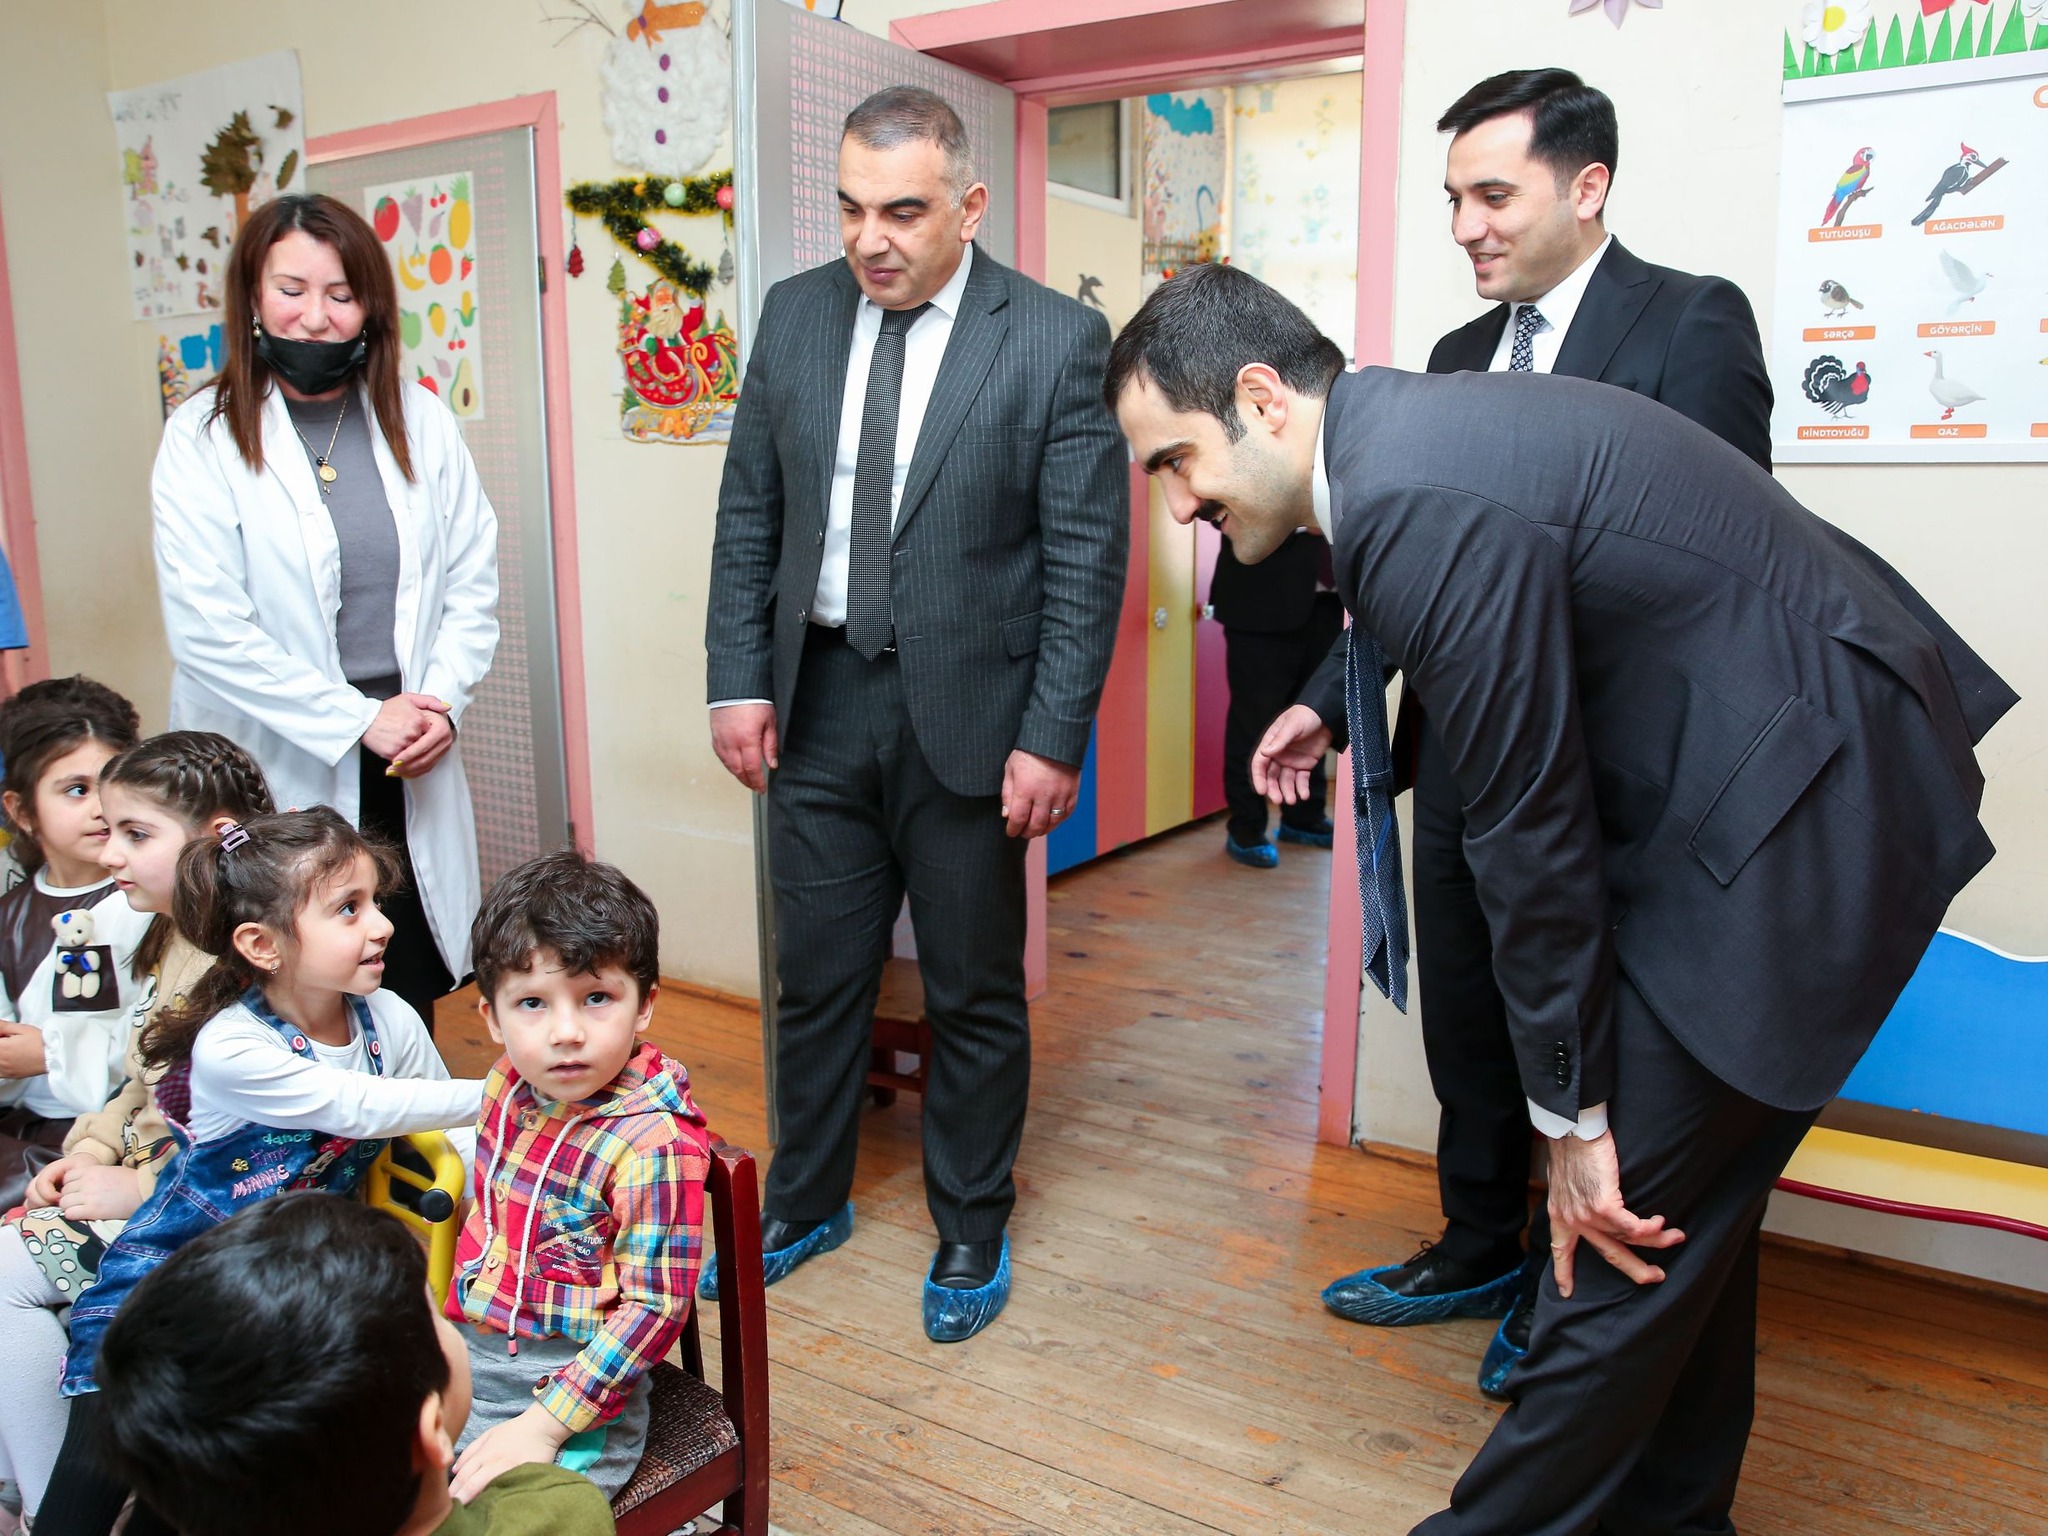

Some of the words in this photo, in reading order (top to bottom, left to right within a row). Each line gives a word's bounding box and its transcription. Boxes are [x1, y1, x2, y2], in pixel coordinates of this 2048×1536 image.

[1932, 219, 1996, 232] AĞACDƏLƏN
[1818, 228, 1871, 239] TUTUQUŞU
[1823, 330, 1854, 340] SƏRÇƏ
[1930, 324, 1982, 335] GÖYƏRÇİN
[1803, 427, 1864, 437] HİNDTOYUĞU
[1938, 428, 1959, 437] QAZ
[262, 1132, 312, 1145] dance
